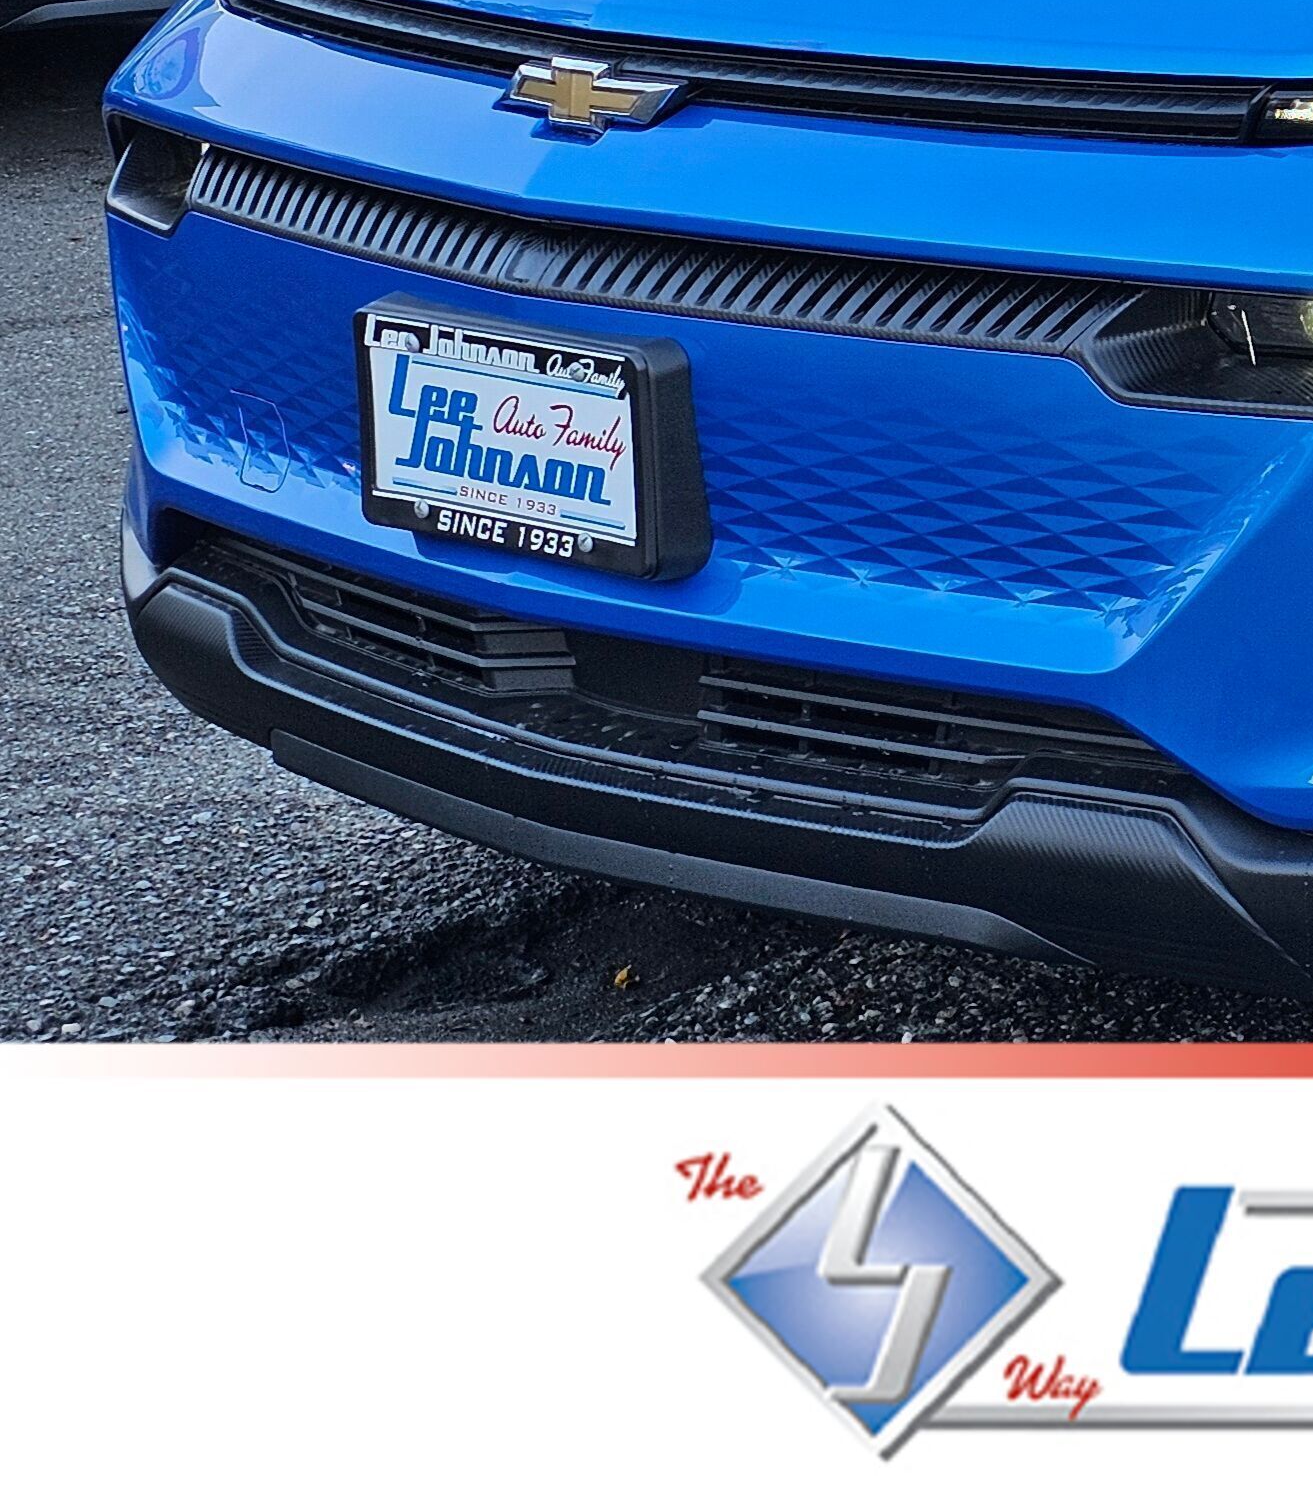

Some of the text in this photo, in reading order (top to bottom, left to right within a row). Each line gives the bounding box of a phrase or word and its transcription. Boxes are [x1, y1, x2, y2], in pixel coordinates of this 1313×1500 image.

[423, 323, 541, 374] Johnson
[579, 358, 626, 399] Family
[389, 354, 627, 471] Lee Auto Family
[396, 414, 612, 506] Johnson
[437, 510, 574, 558] SINCE 1933
[459, 485, 557, 515] SINCE 1933
